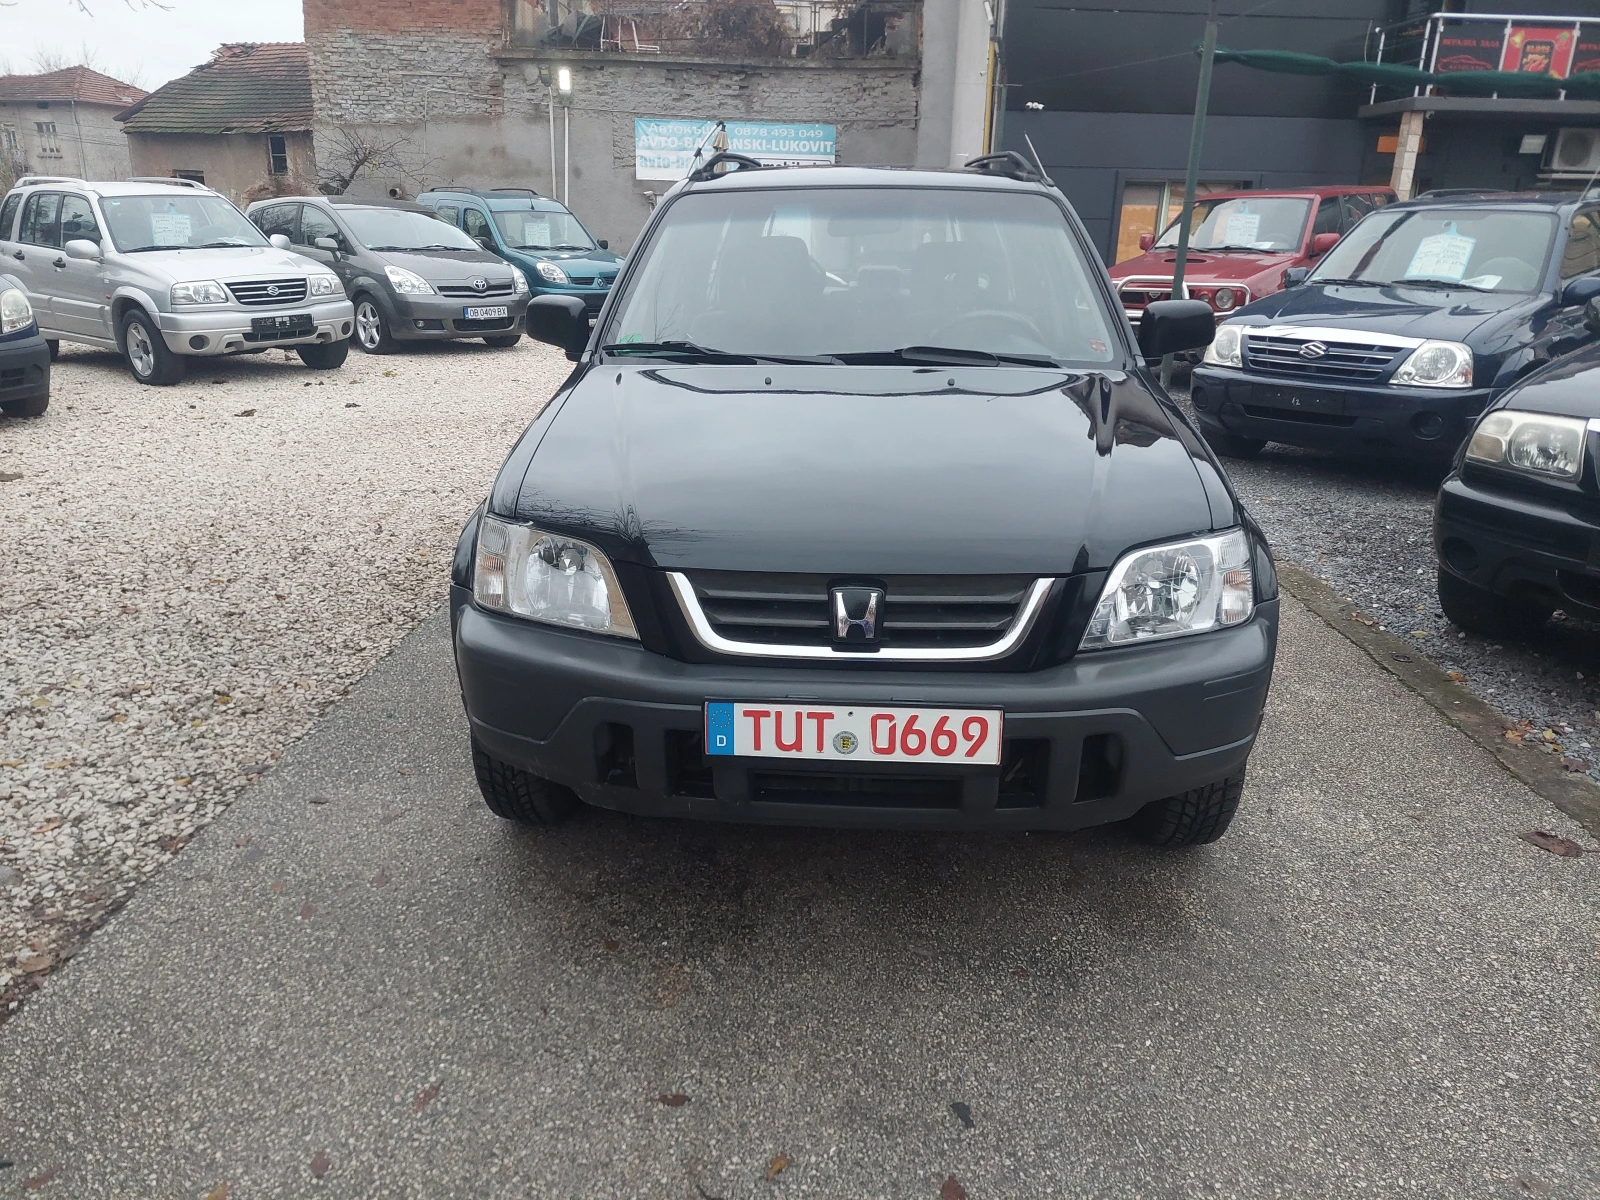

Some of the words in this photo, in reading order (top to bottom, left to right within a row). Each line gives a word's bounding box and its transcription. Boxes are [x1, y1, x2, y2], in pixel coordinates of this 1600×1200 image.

[648, 122, 714, 136] Автокъщ
[734, 127, 767, 137] 0878
[771, 128, 795, 138] 493
[798, 129, 823, 138] 049
[638, 135, 834, 153] AVTO-BALANSKI-LUKOVIT
[480, 308, 497, 317] 0409
[743, 709, 835, 753] TUT
[870, 713, 989, 757] 0669
[716, 734, 727, 747] D
